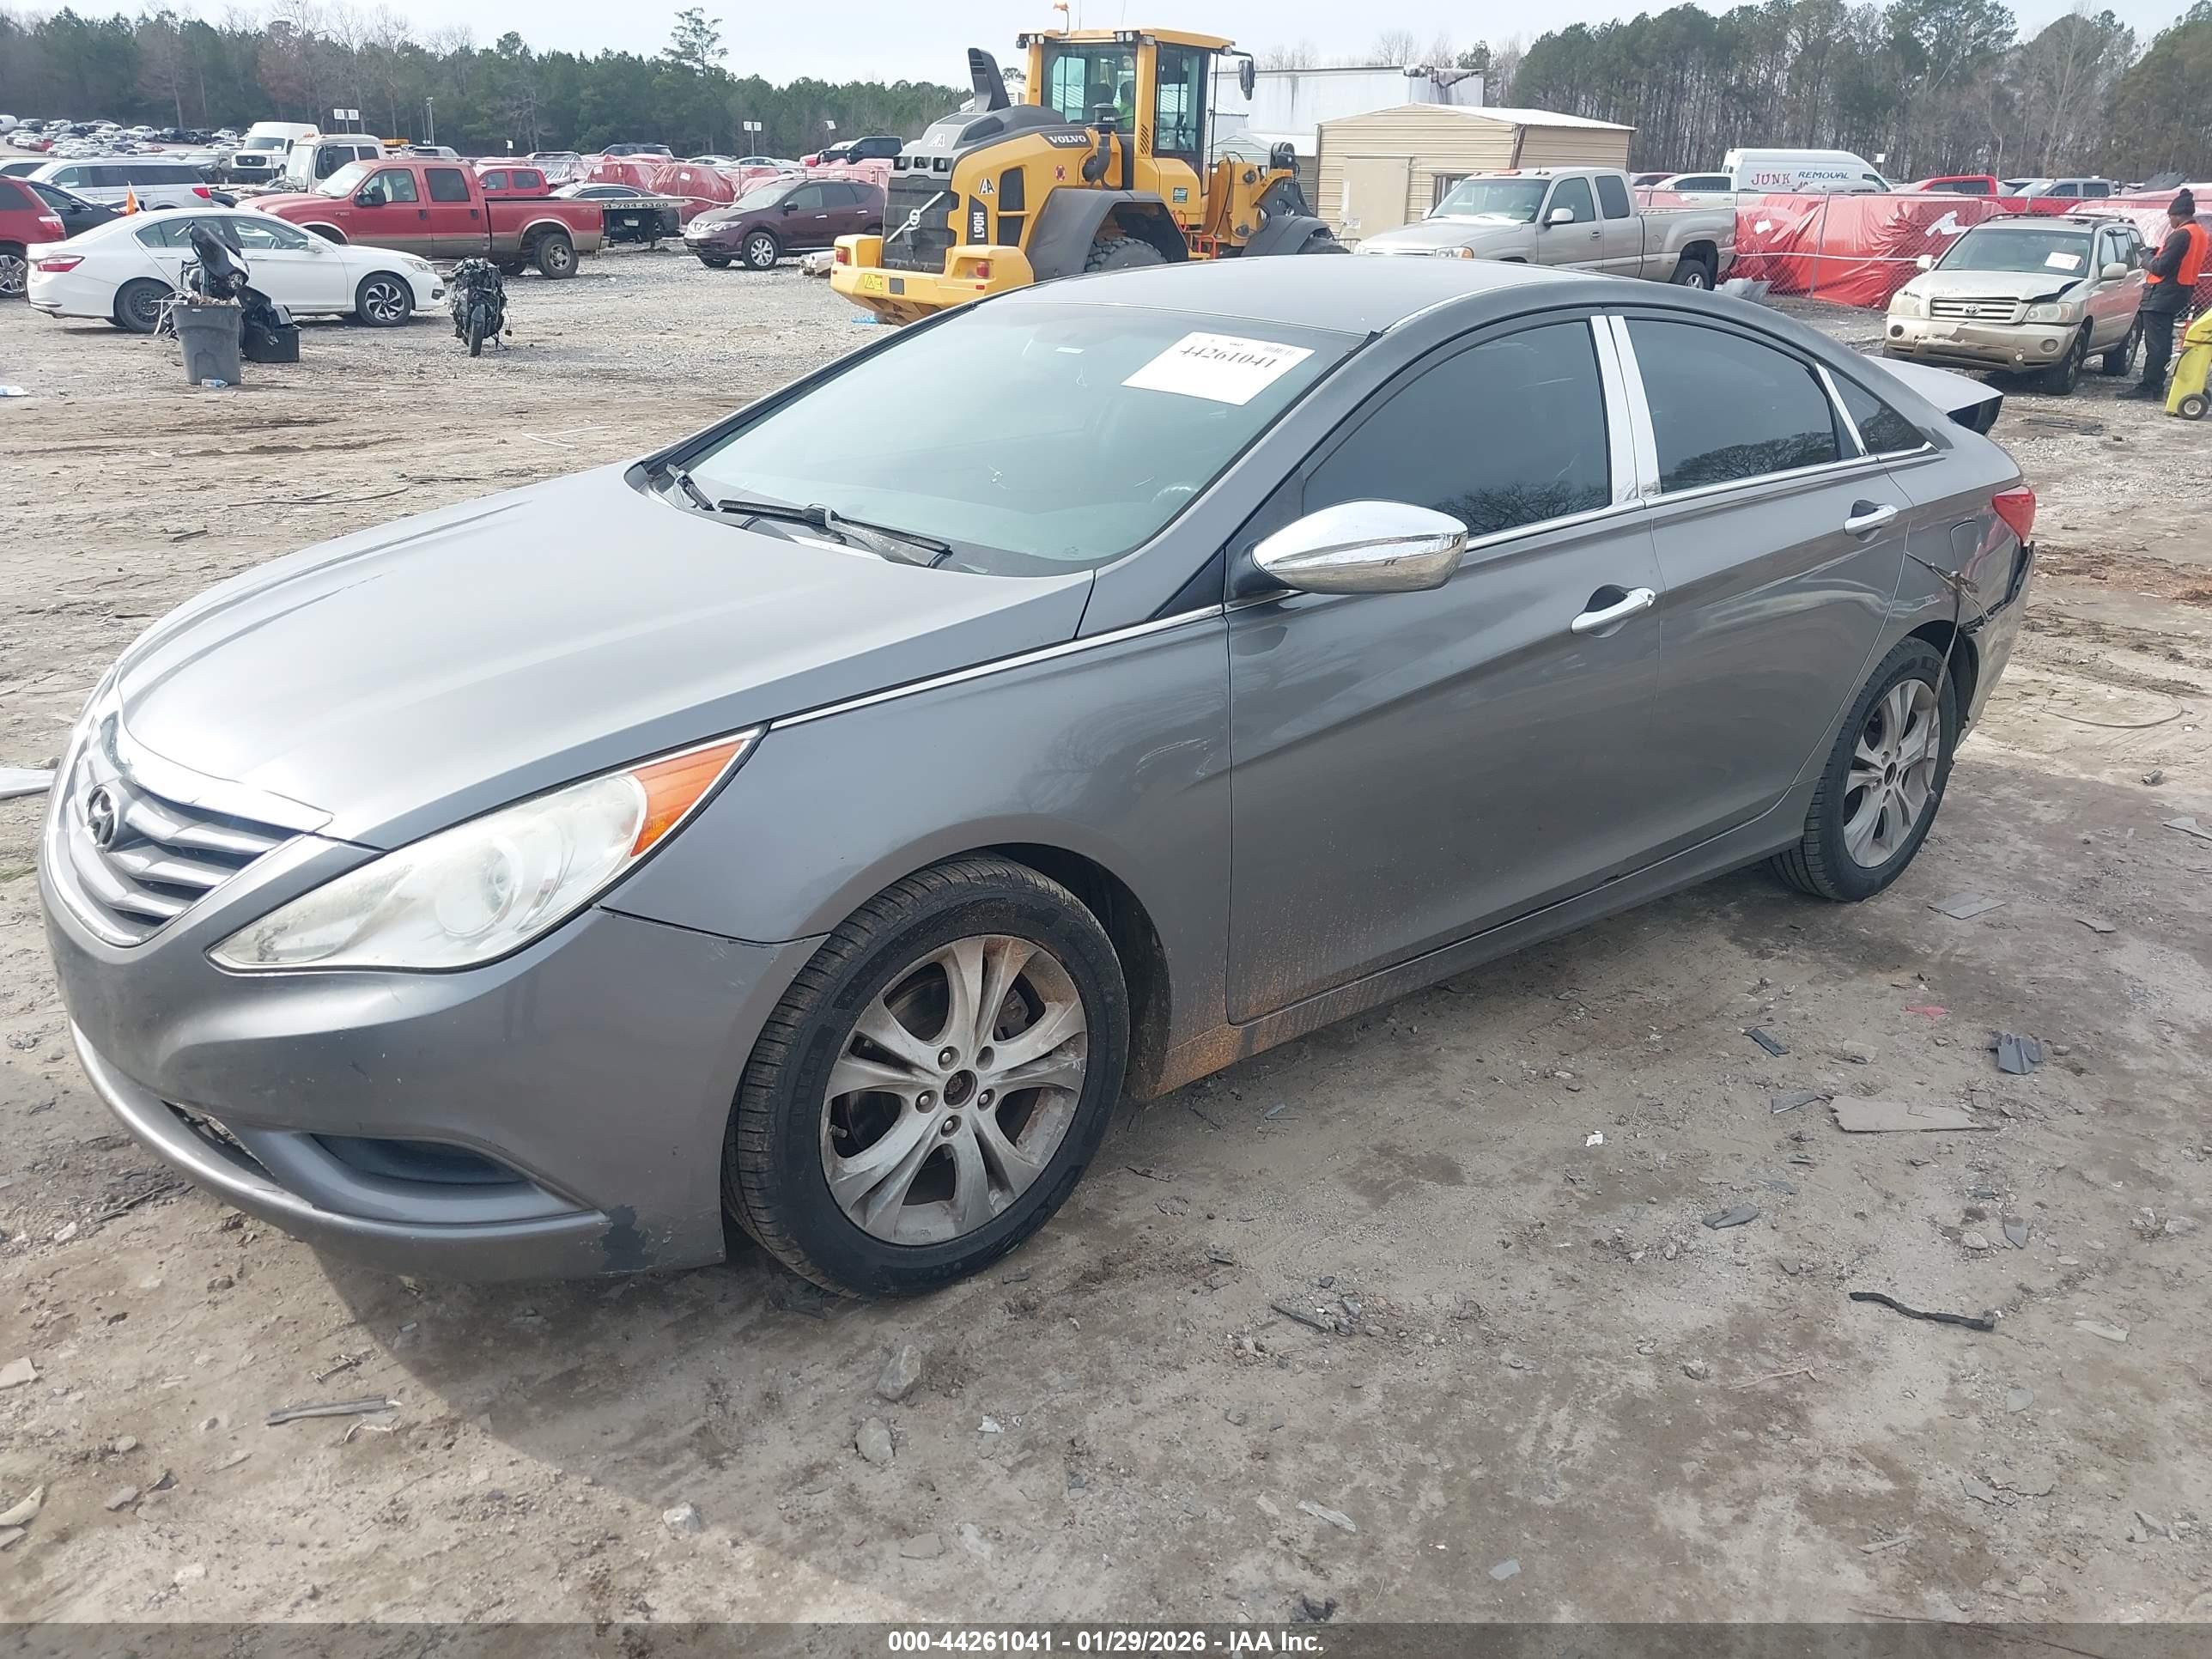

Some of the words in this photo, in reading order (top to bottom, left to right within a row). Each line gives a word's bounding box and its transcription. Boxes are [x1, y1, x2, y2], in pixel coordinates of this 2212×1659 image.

[1048, 135, 1087, 144] VOLVO
[1751, 173, 1790, 185] JUNK
[1798, 171, 1850, 179] REMOVAL
[973, 212, 985, 239] L90H
[1180, 345, 1278, 368] 44261041
